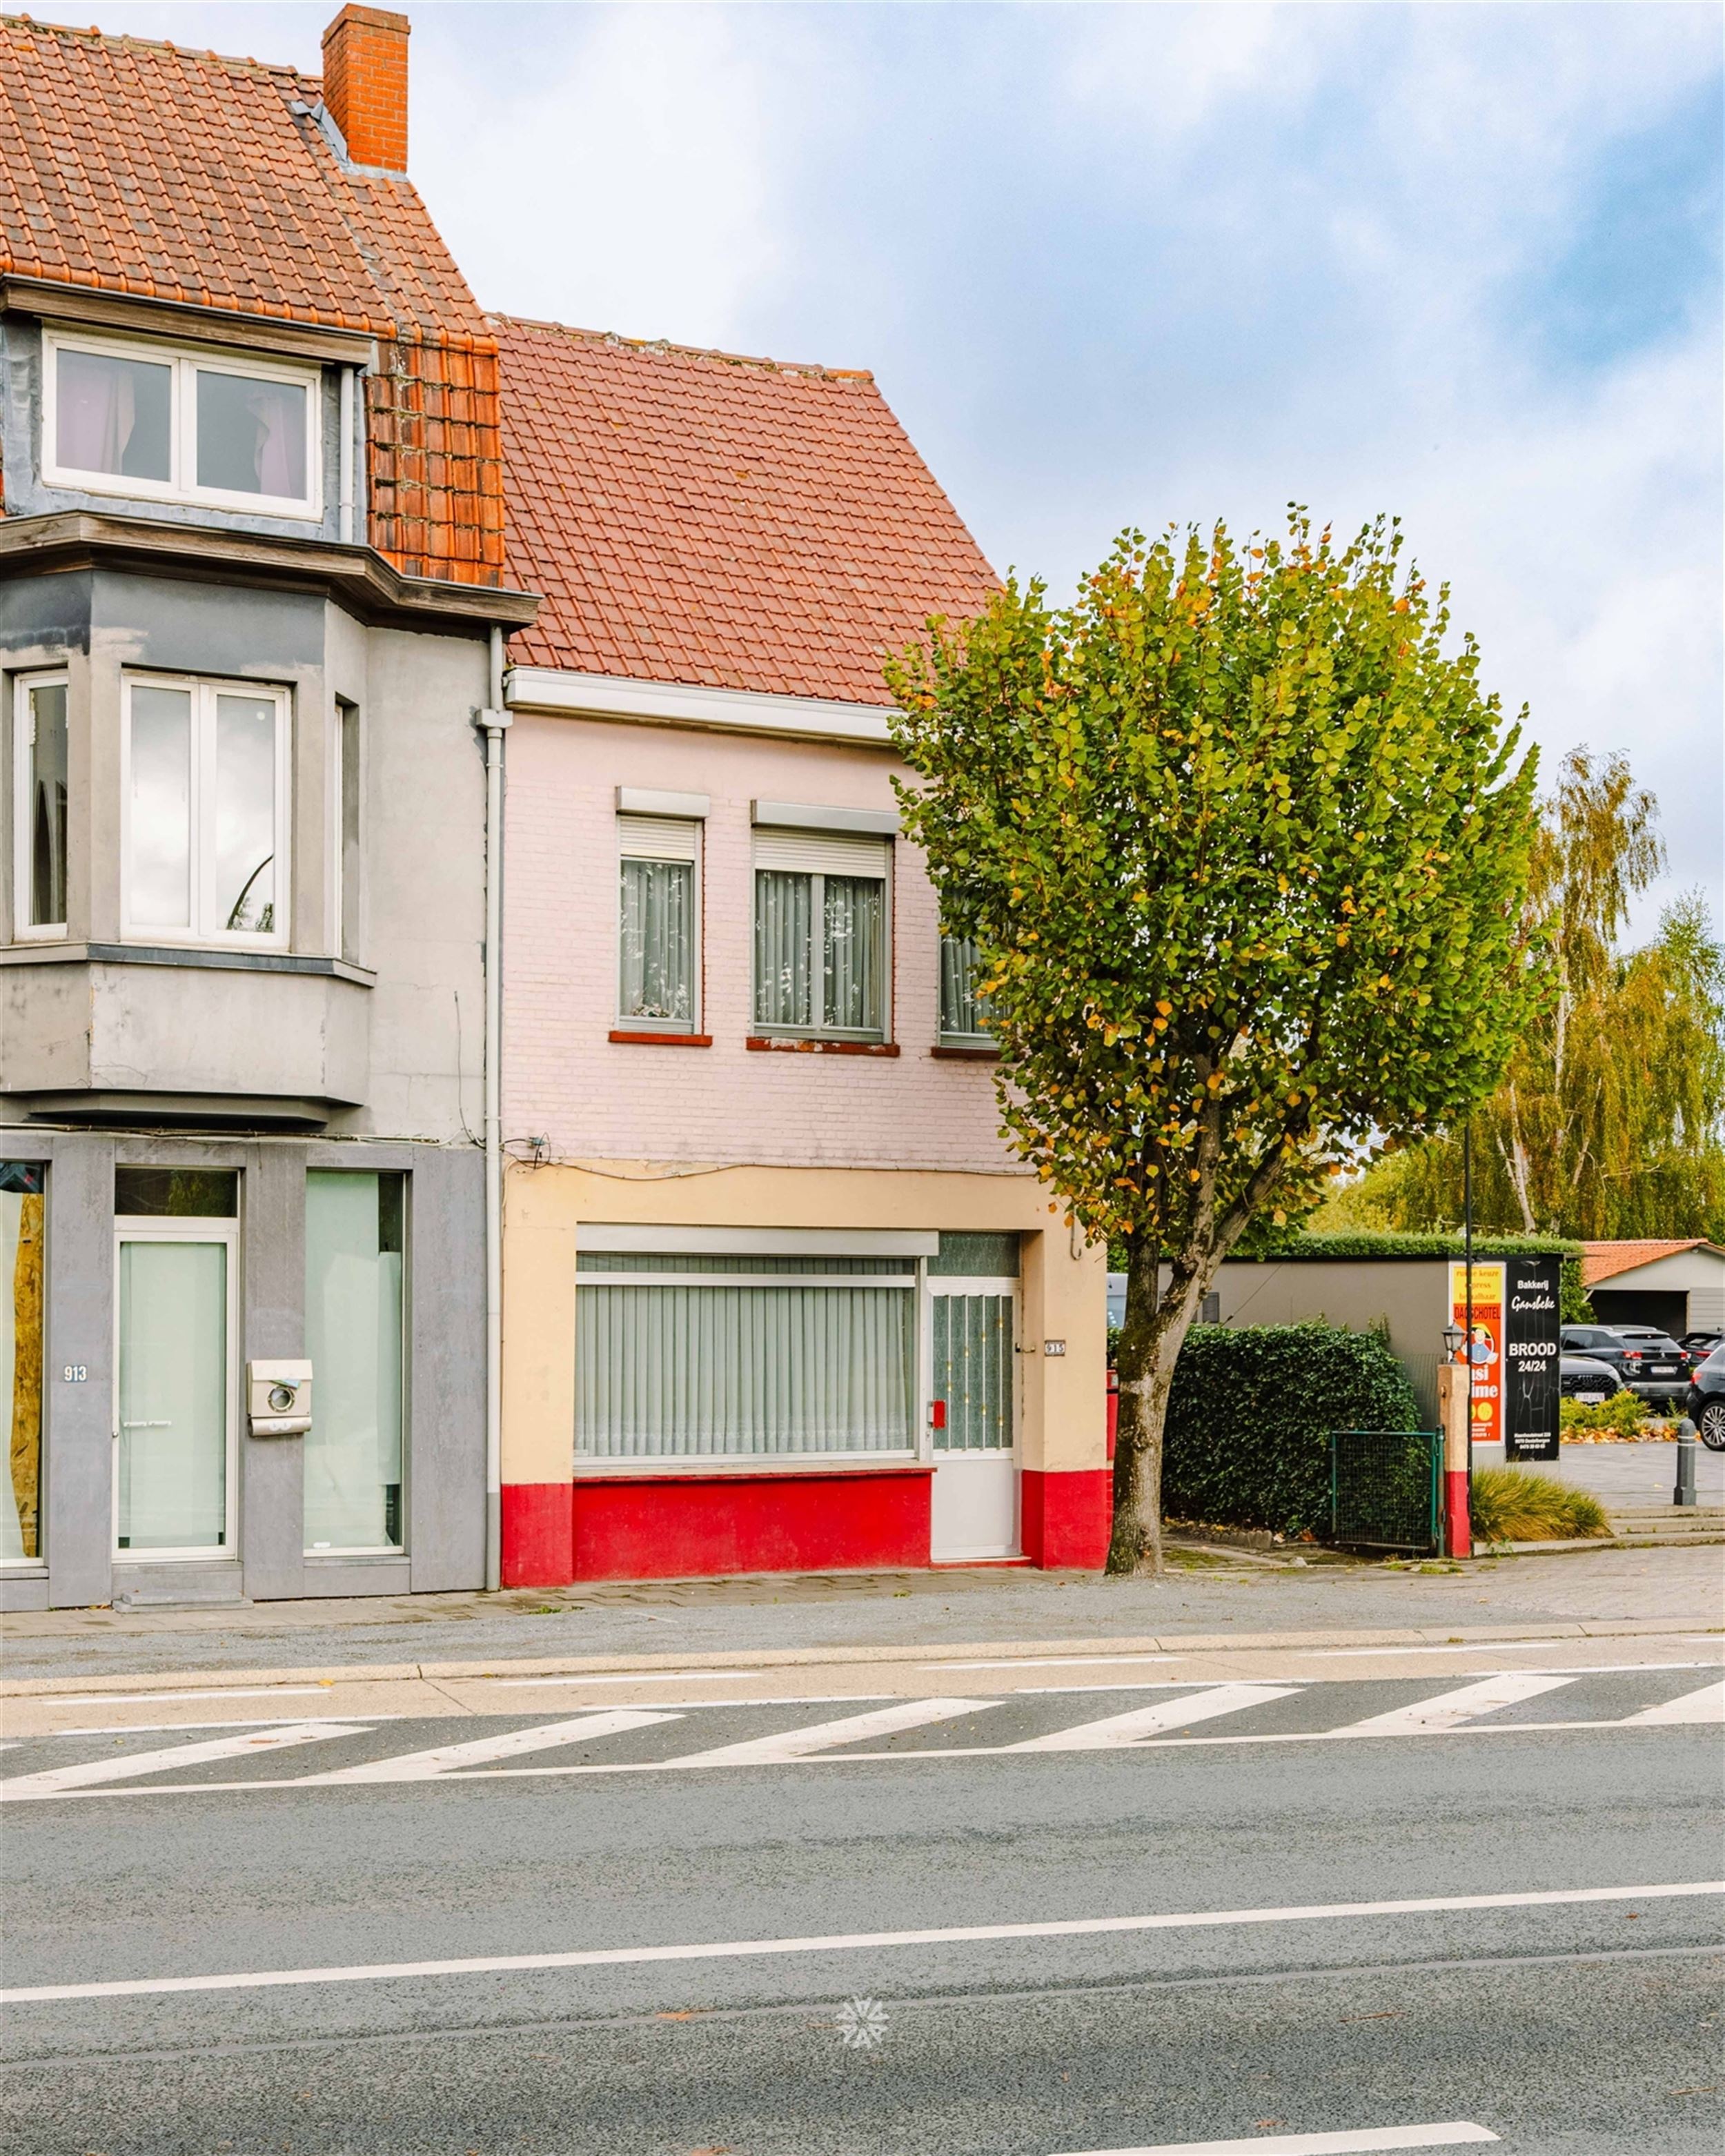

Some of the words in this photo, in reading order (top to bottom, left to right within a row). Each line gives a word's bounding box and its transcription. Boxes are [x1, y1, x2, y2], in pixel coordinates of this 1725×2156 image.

[1517, 1280, 1549, 1291] Bakkerij
[1511, 1295, 1555, 1312] Gansbeke
[1509, 1343, 1557, 1356] BROOD
[64, 1365, 87, 1381] 913
[1518, 1360, 1547, 1372] 24/24
[1471, 1382, 1499, 1398] ime
